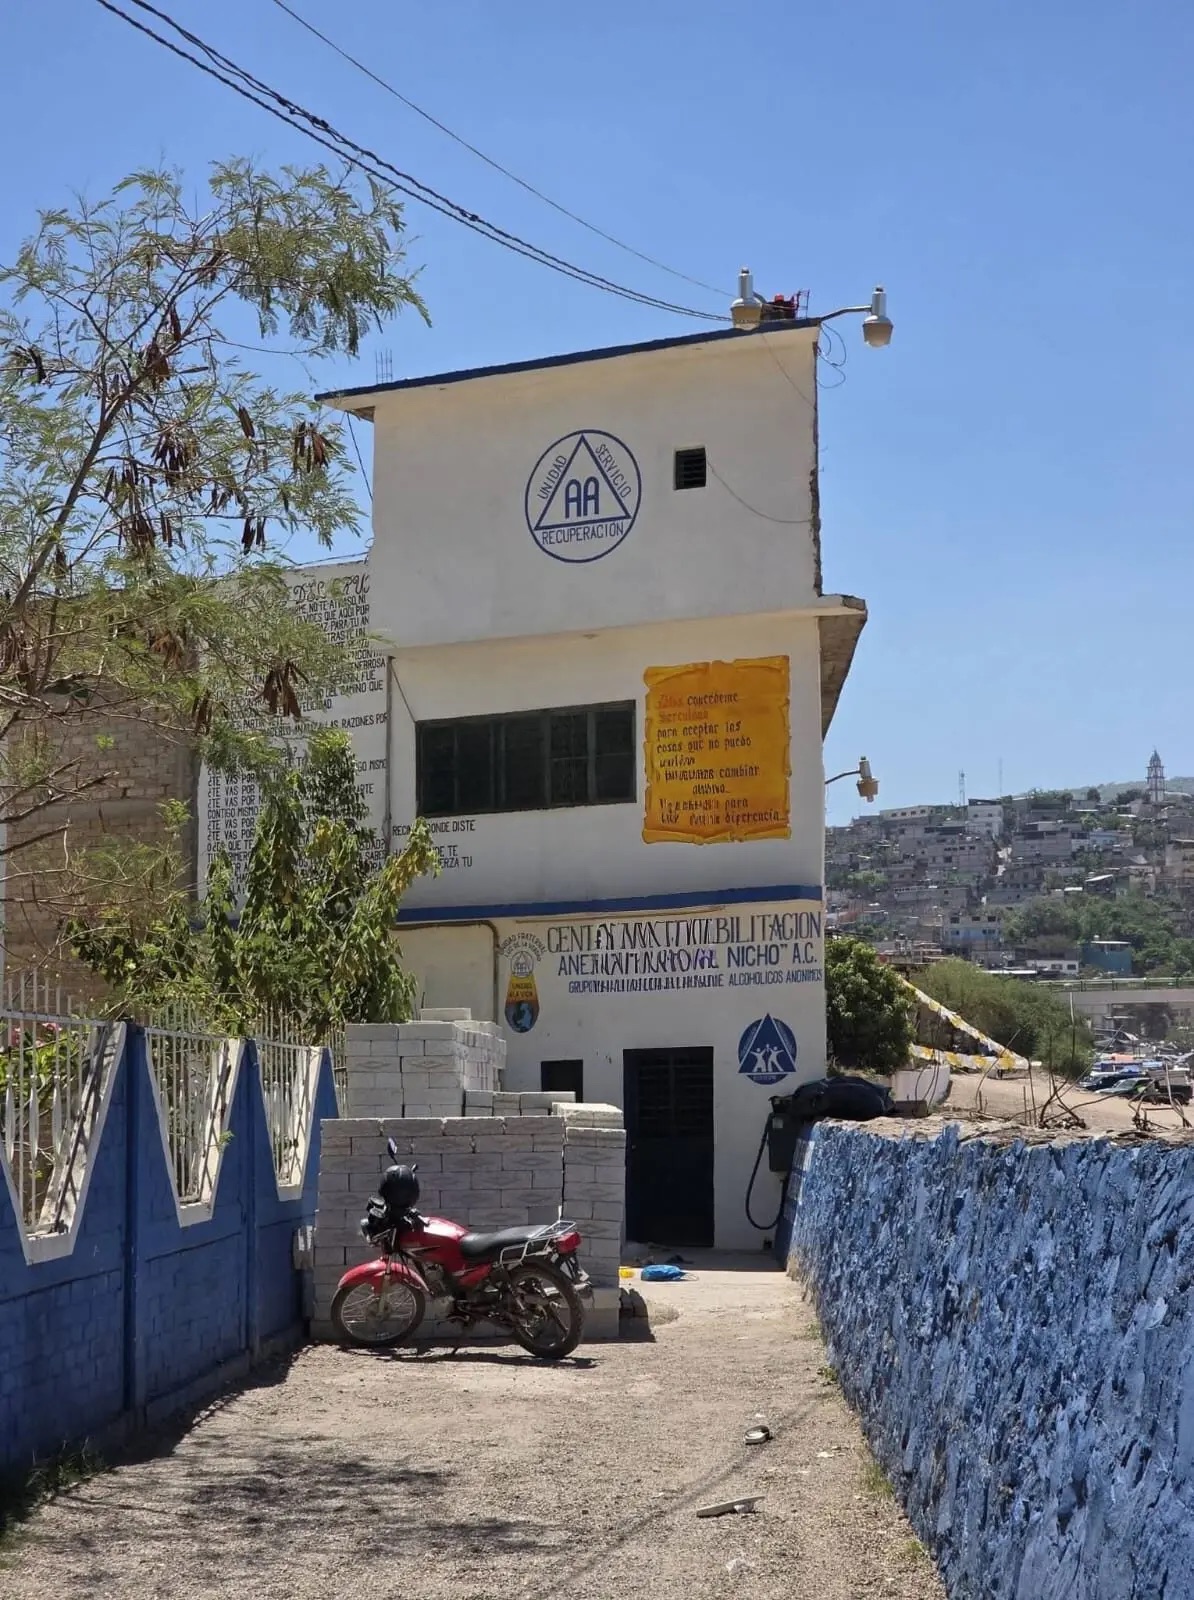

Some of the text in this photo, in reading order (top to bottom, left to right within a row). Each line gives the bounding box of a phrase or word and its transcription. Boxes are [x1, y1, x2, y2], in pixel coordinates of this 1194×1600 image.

[537, 455, 567, 500] UNIDAD
[595, 443, 632, 498] SERVICIO
[565, 476, 599, 519] AA
[542, 522, 624, 545] RECUPERACION
[341, 713, 375, 729] RAZONES
[683, 721, 719, 738] aceptar
[225, 774, 238, 785] VAS
[225, 785, 239, 796] VAS
[241, 784, 255, 794] POR
[225, 796, 238, 807] VAS
[241, 795, 255, 806] POR
[207, 808, 236, 819] CONTIGO
[224, 818, 238, 829] VAS
[241, 817, 255, 828] POR
[452, 819, 476, 833] DISTE
[224, 830, 238, 840] VAS
[228, 841, 241, 851] QUE
[462, 855, 473, 868] TU
[792, 941, 817, 965] A.C.
[728, 970, 784, 986] ALCOHOLICOS
